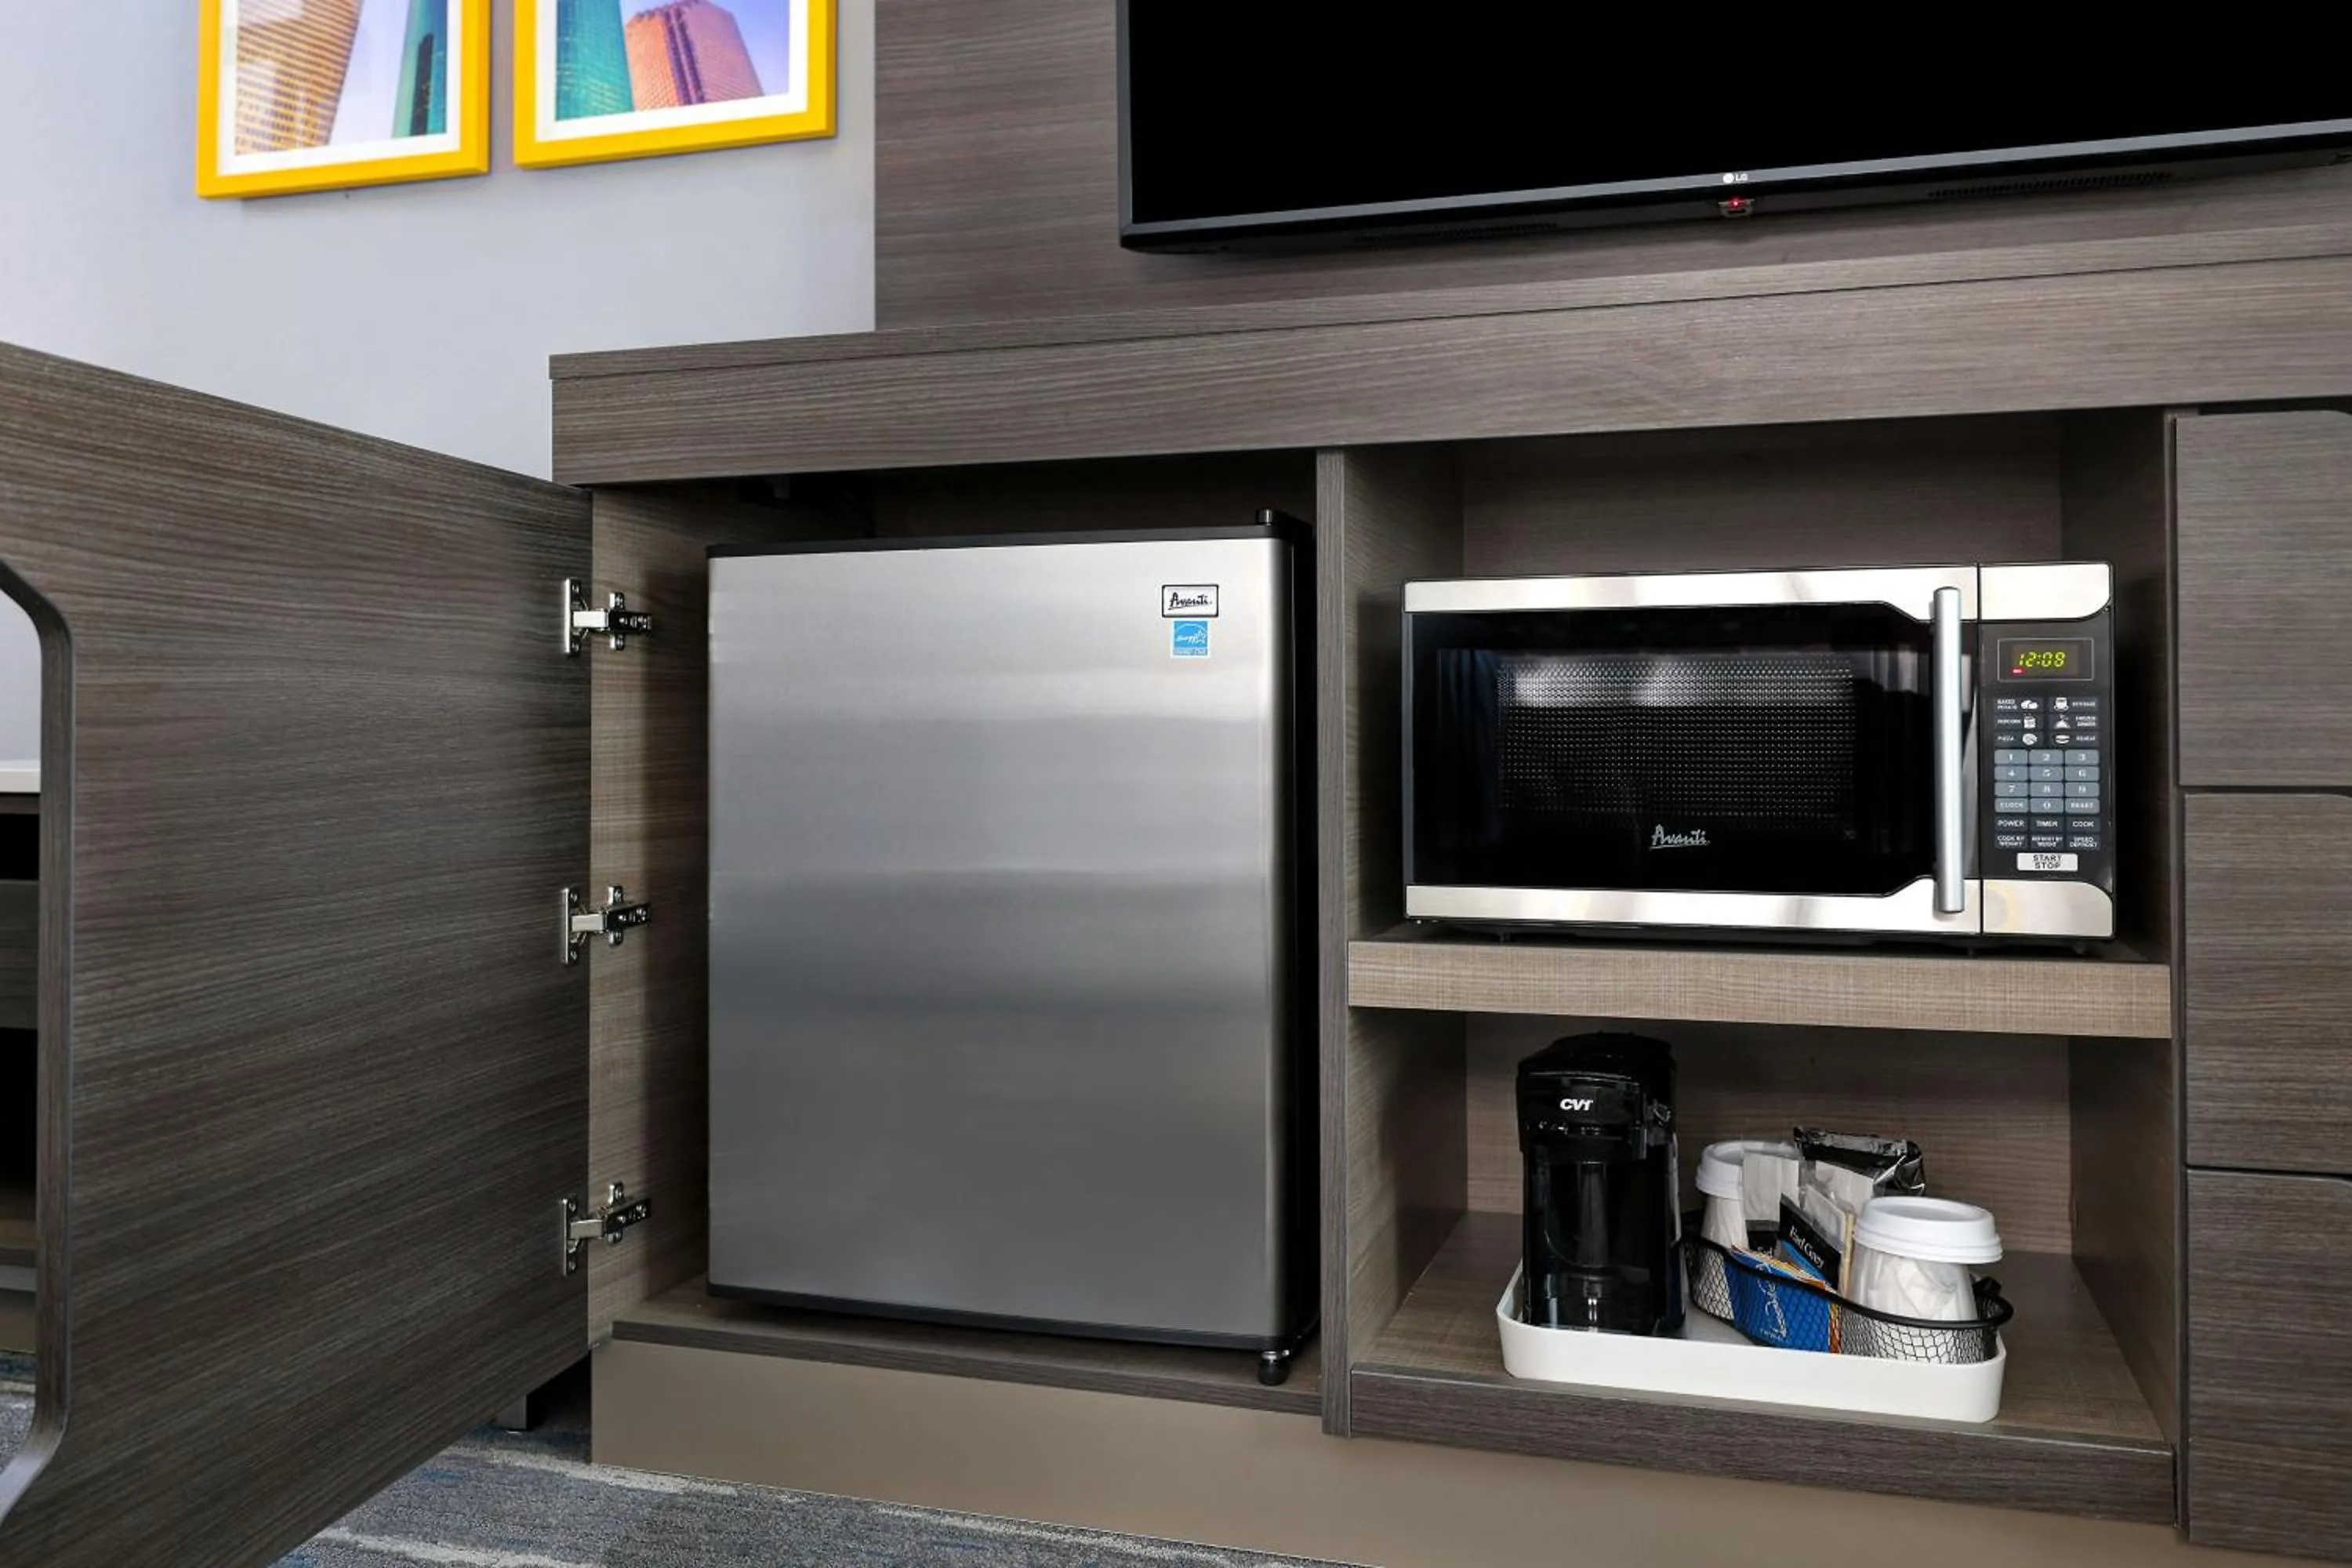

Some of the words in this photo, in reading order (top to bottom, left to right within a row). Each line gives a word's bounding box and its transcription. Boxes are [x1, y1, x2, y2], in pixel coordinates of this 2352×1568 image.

[2019, 652, 2066, 667] 12:08
[2008, 785, 2016, 793] 7
[1650, 824, 1709, 848] Avanti
